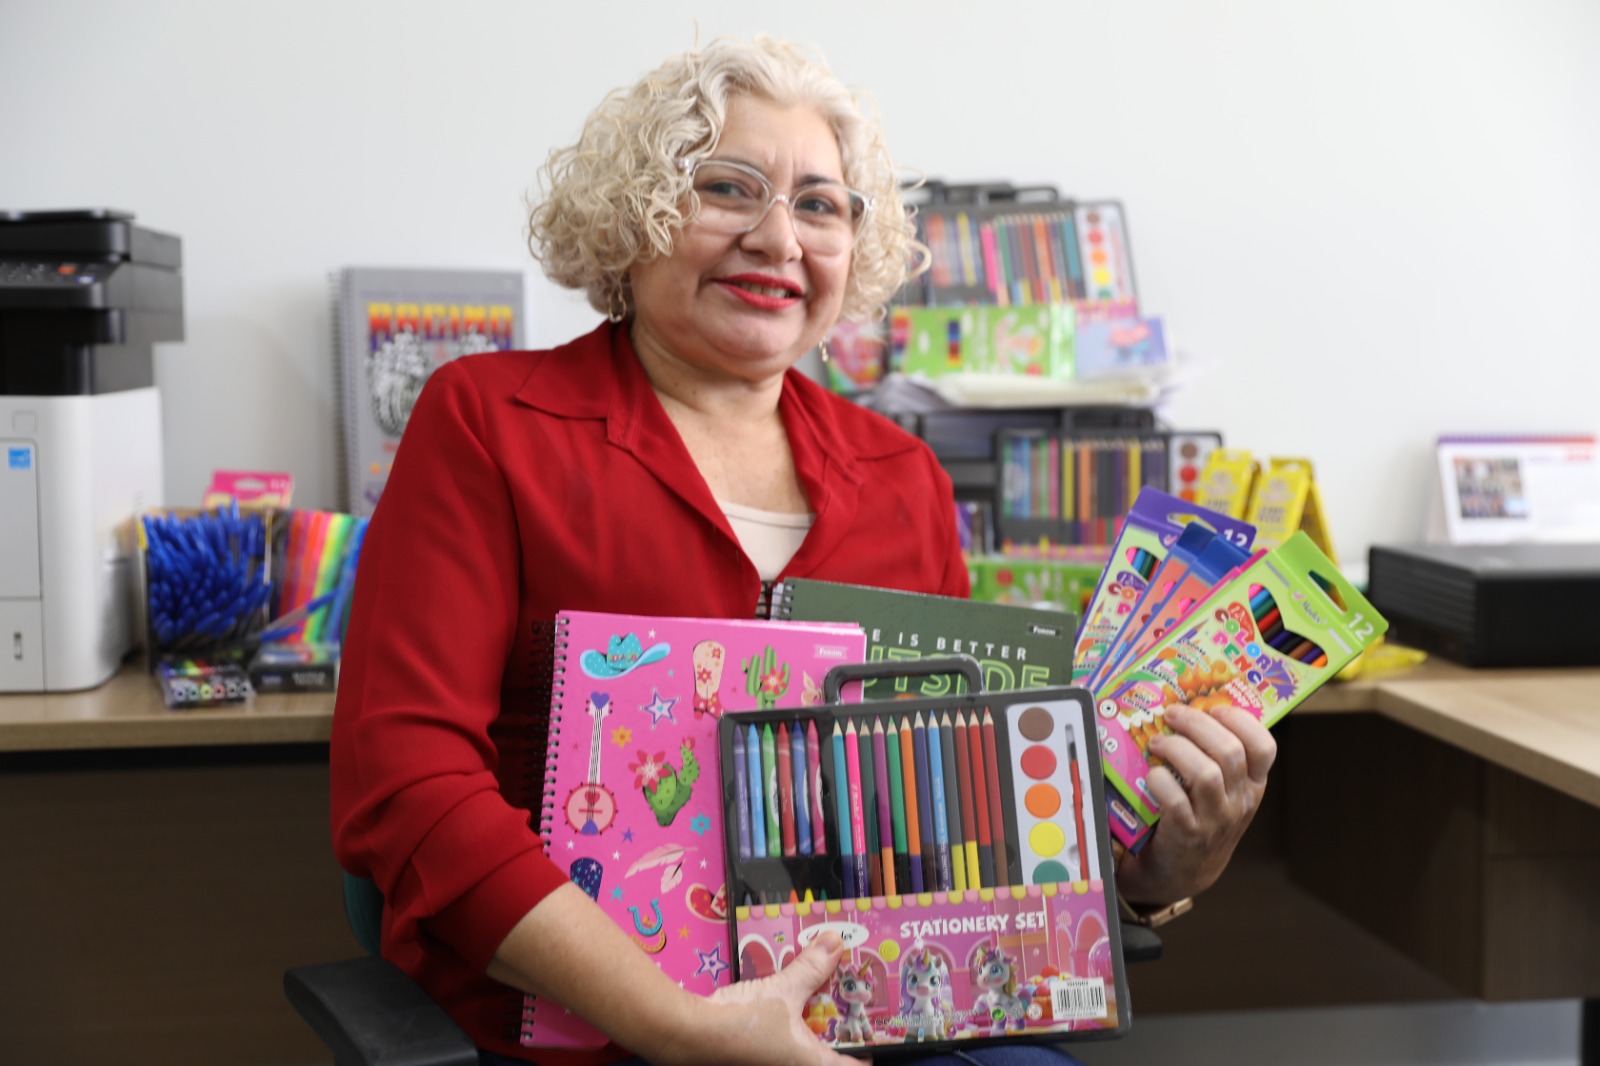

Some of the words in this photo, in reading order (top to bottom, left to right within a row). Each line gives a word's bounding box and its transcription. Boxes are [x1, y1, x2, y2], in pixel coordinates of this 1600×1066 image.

[1213, 607, 1272, 673] COLOR
[1347, 611, 1375, 643] 12
[899, 632, 919, 648] IS
[937, 636, 1027, 662] BETTER
[1210, 628, 1278, 708] PENCIL
[900, 914, 1009, 939] STATIONERY
[1015, 911, 1047, 930] SET
